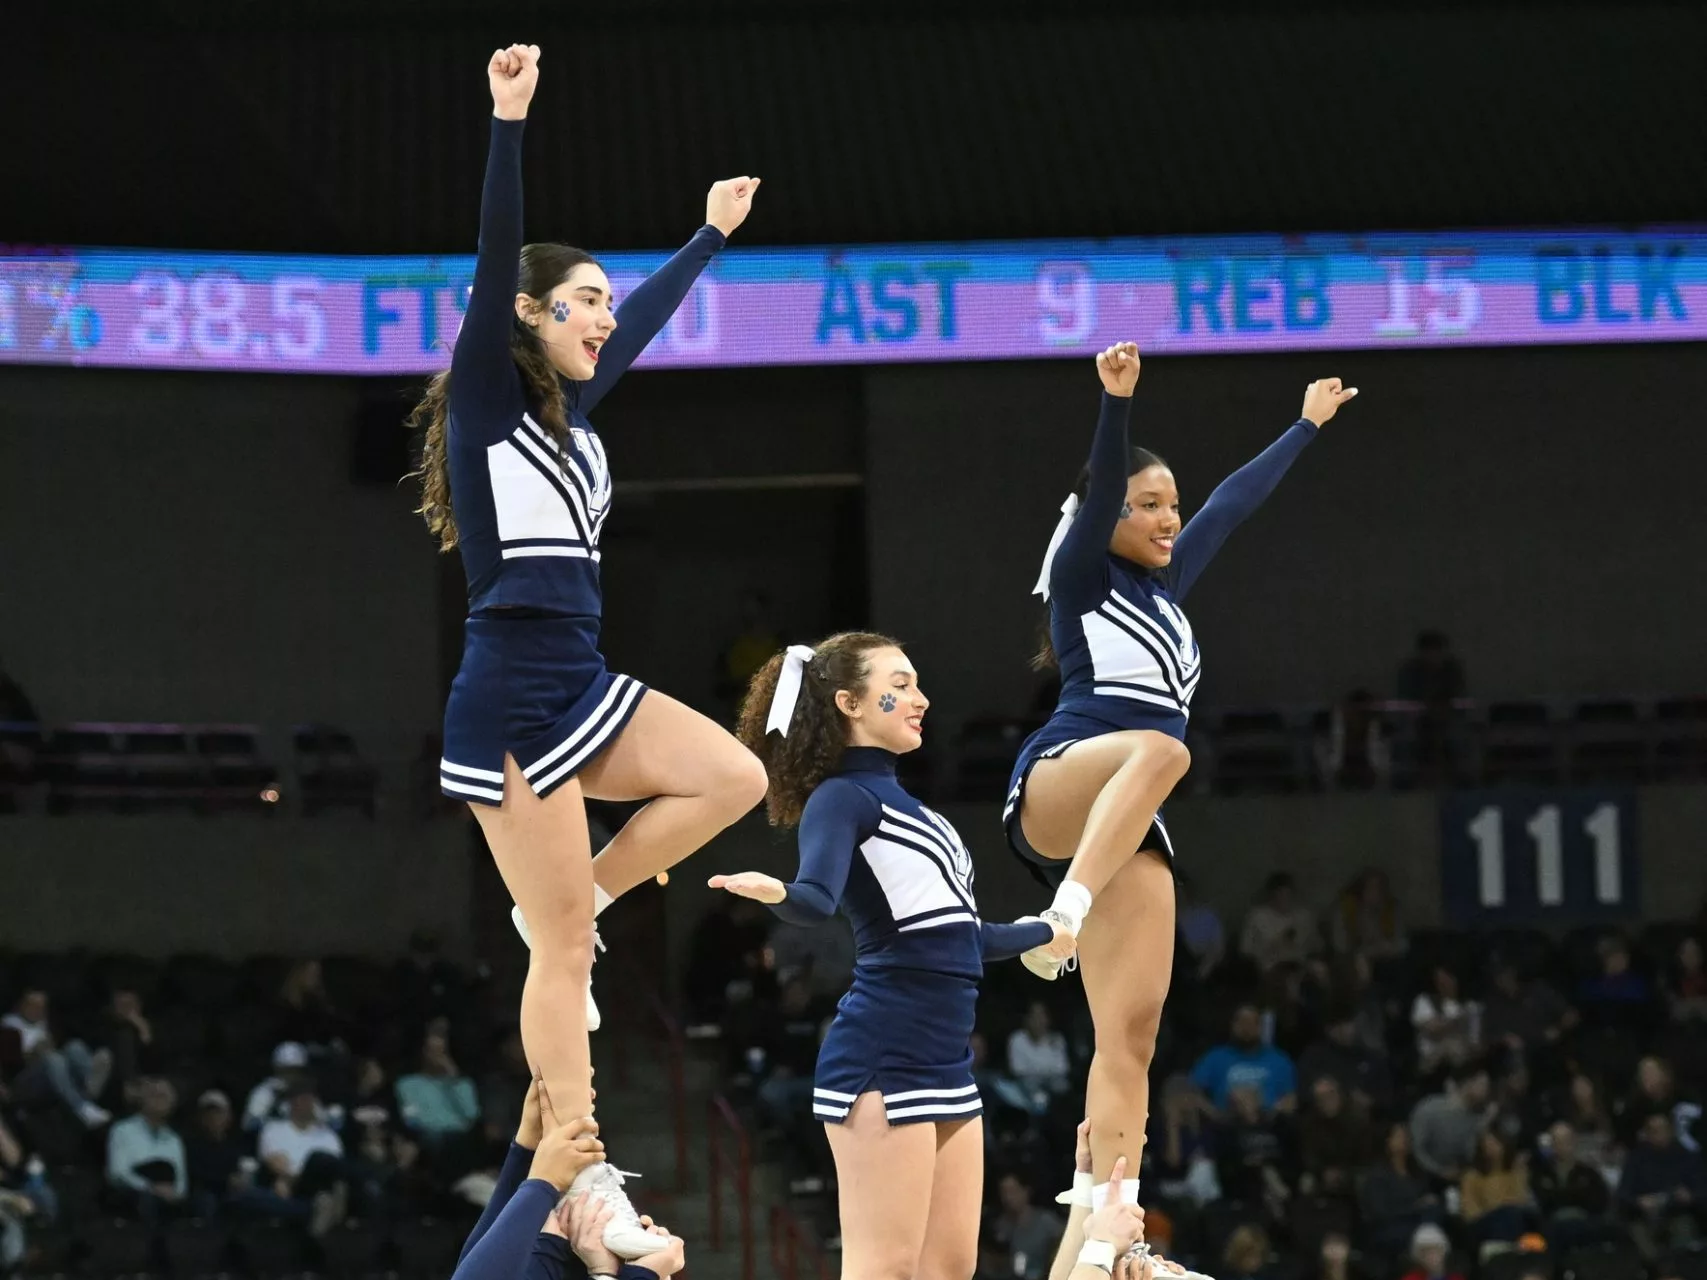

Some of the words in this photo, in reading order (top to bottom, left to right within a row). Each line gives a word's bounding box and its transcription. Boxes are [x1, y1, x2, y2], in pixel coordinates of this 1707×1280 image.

[131, 270, 326, 356] 38.5
[363, 274, 475, 356] FT
[815, 258, 970, 343] AST
[1037, 261, 1097, 346] 9
[1173, 252, 1332, 334] REB
[1372, 250, 1482, 337] 15
[1538, 244, 1689, 323] BLK
[1468, 803, 1622, 907] 111
